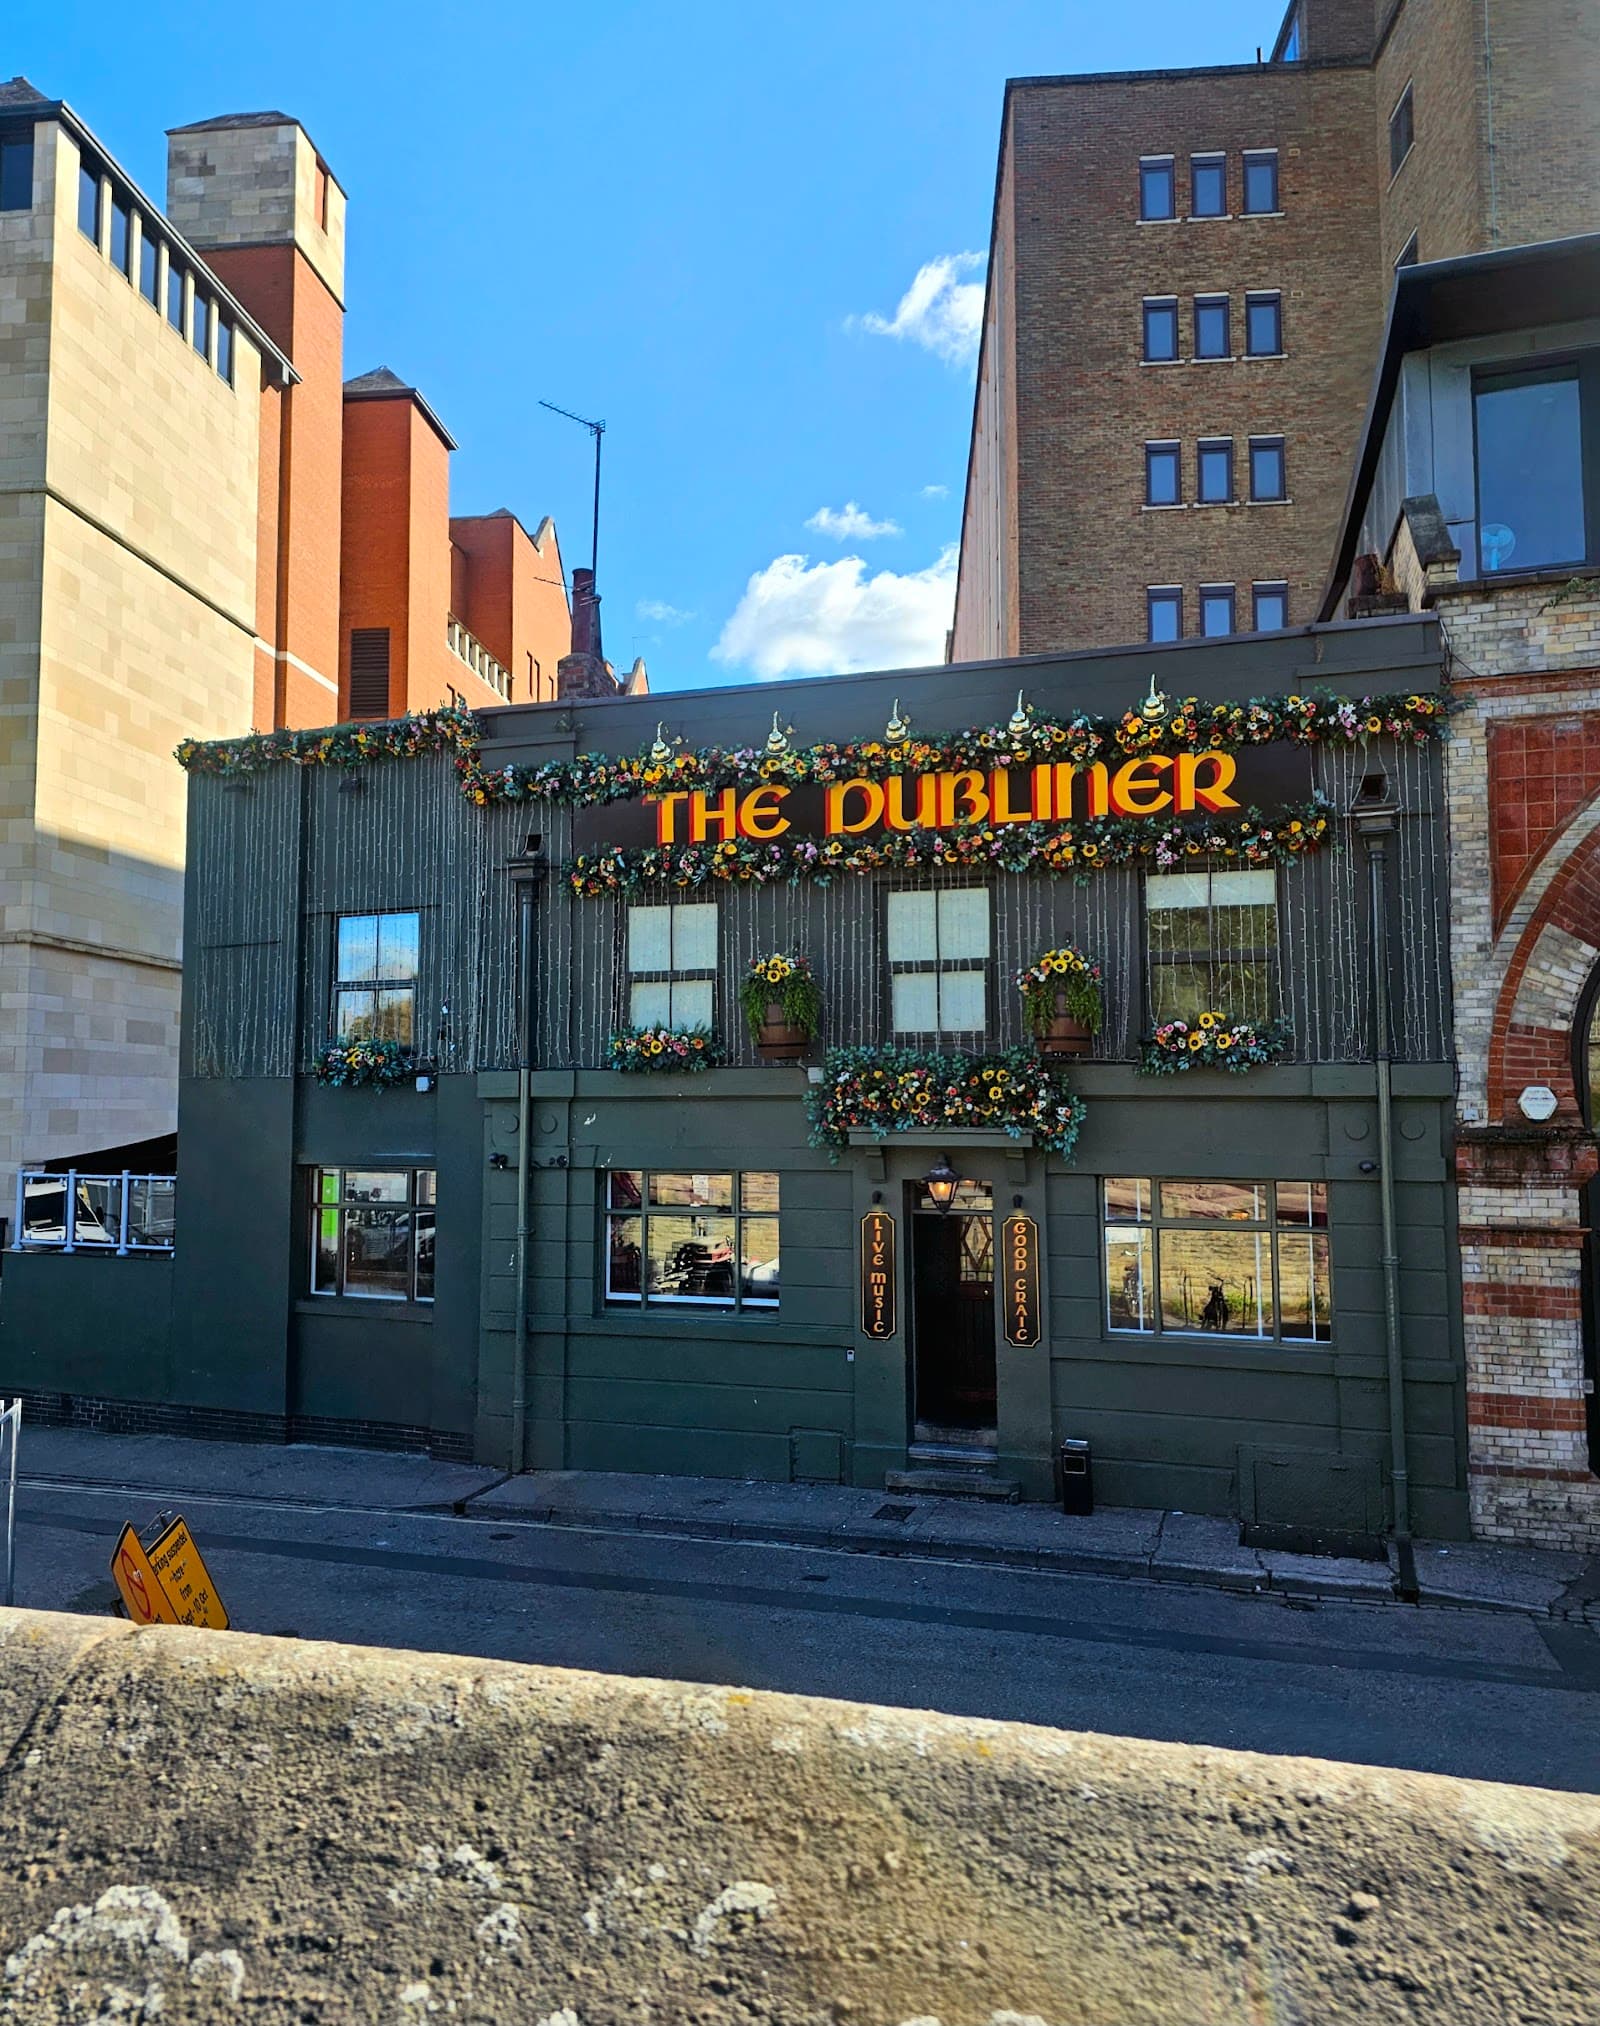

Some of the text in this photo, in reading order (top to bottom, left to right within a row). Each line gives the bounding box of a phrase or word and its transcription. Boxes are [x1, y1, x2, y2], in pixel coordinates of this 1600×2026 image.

[642, 750, 1241, 847] THE DUBLINER
[1013, 1222, 1028, 1341] GOOD CRAIC
